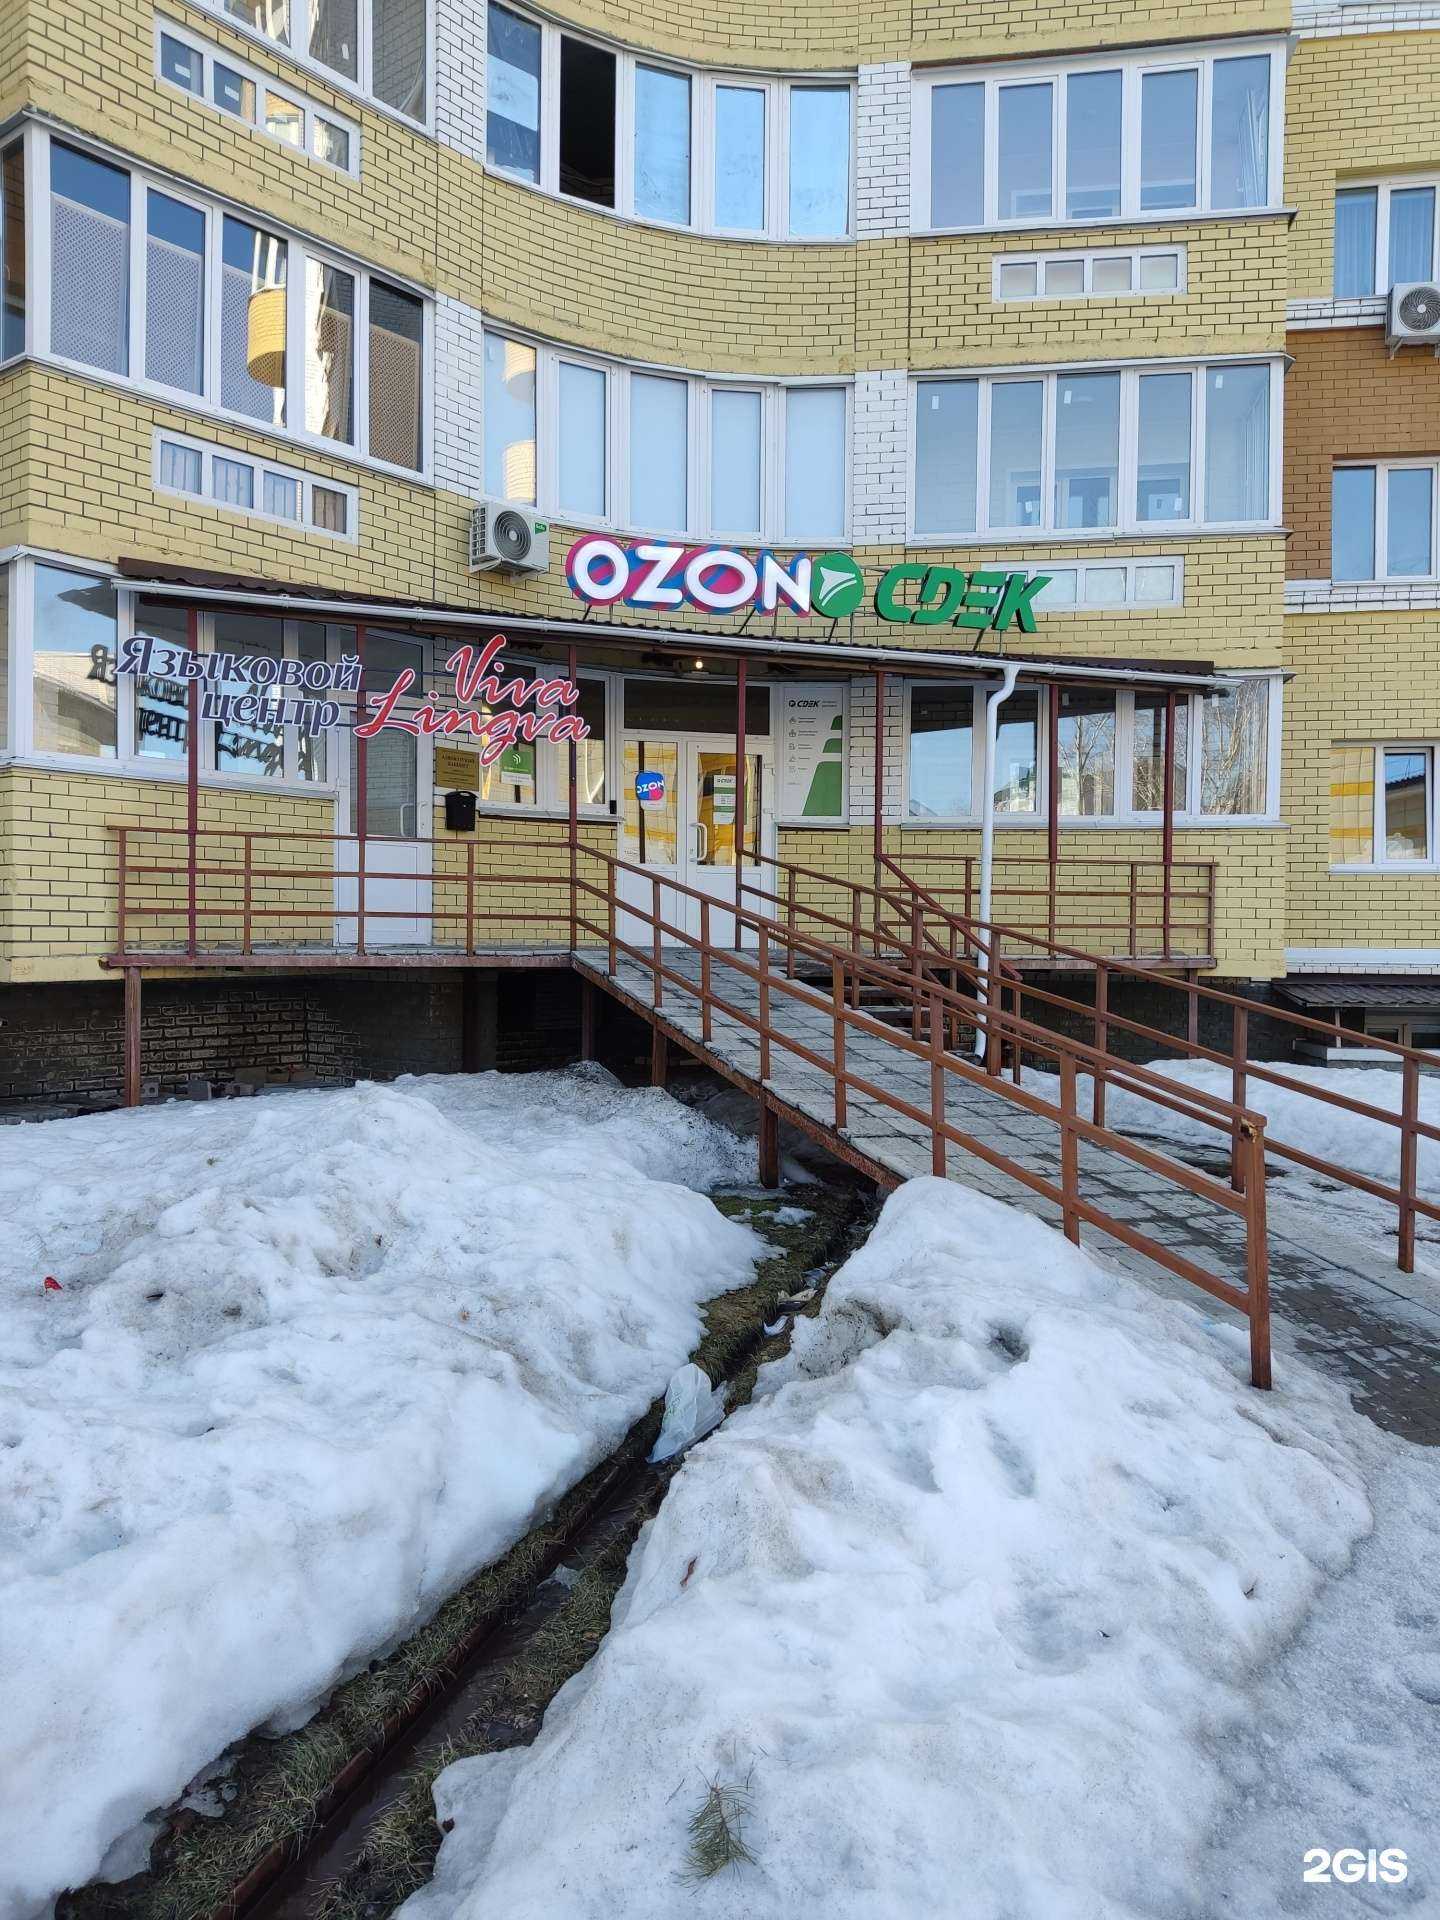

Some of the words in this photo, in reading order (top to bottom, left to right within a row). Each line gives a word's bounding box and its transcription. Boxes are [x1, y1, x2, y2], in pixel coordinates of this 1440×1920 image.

[566, 533, 811, 618] OZON
[874, 563, 1054, 633] CDEK
[114, 636, 363, 692] Языковой
[446, 634, 580, 708] Viva
[200, 691, 341, 738] центр
[353, 669, 591, 767] Lingva
